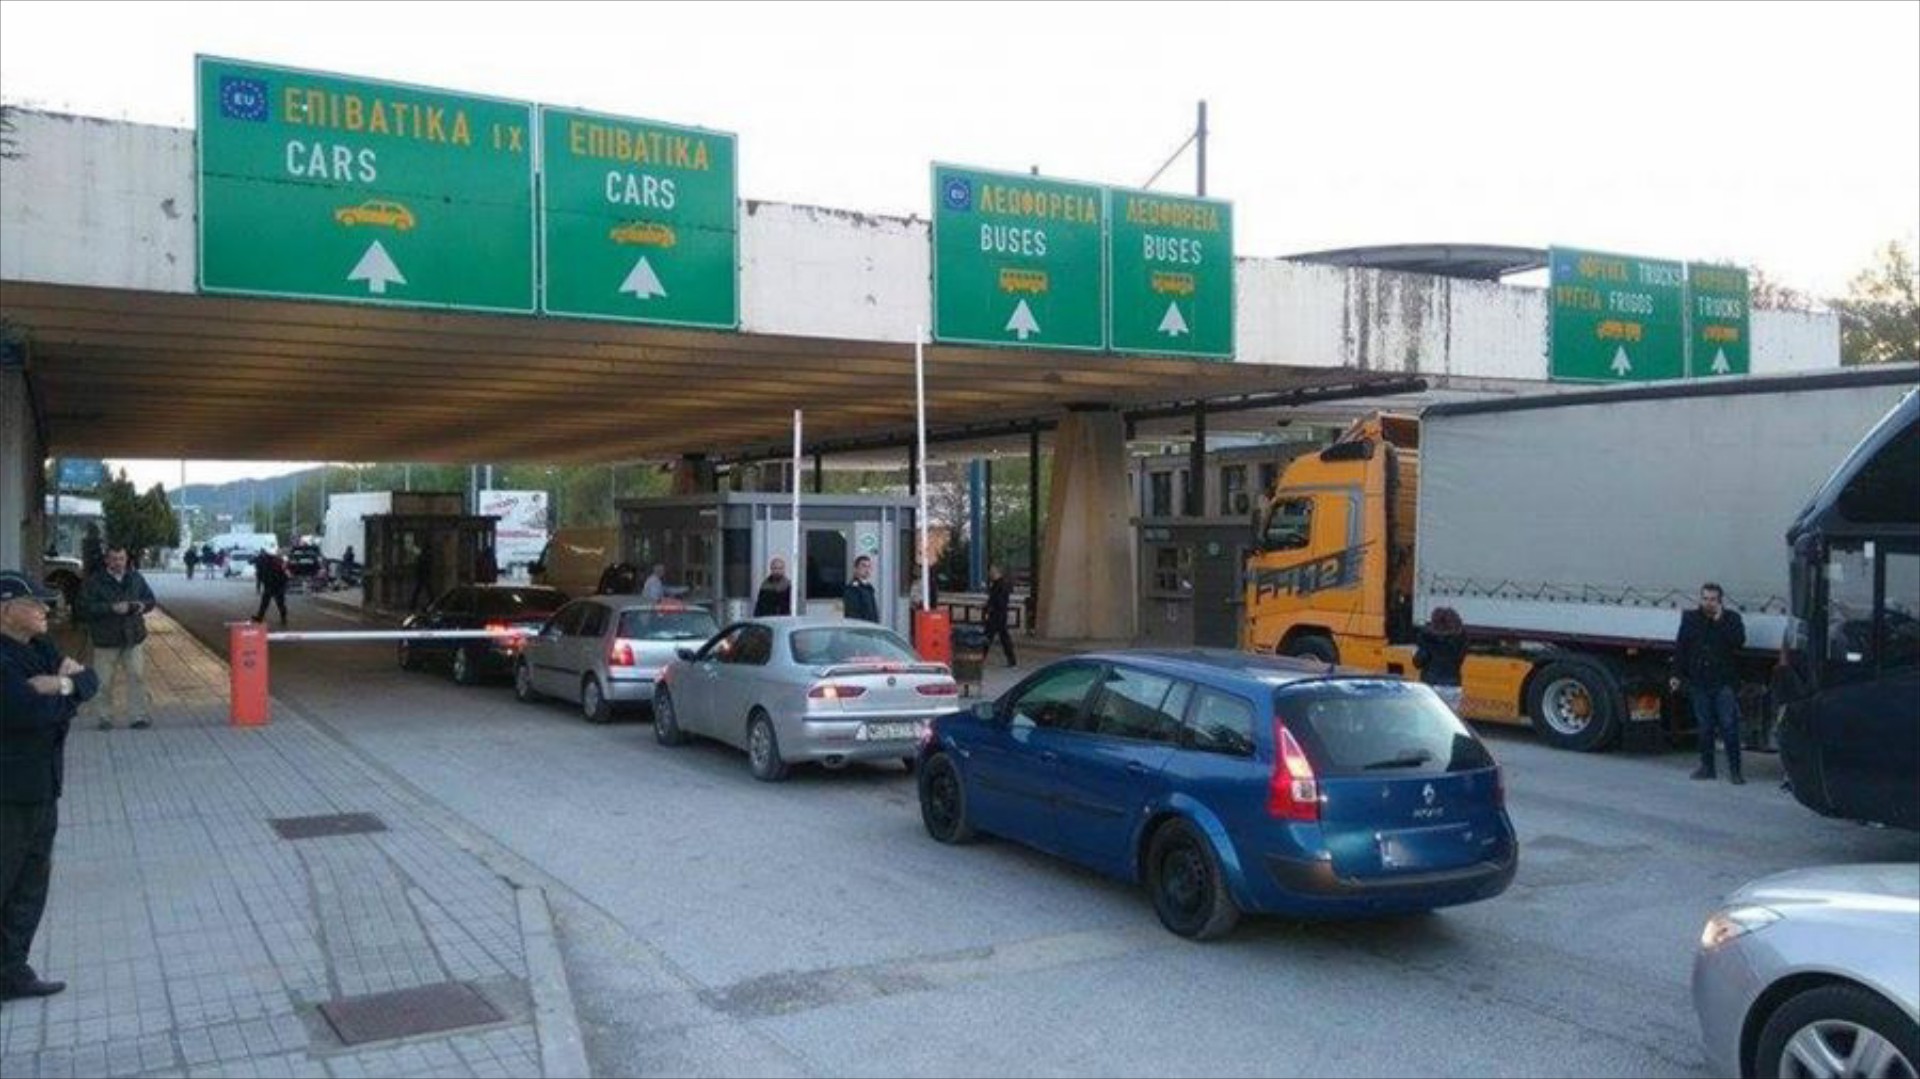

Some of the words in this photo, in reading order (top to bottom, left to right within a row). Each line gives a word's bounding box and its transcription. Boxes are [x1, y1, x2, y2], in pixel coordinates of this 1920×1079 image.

[233, 92, 255, 106] EU
[283, 86, 471, 146] ΕΠΙΒΑΤΙΚΑ
[286, 140, 377, 183] CARS
[570, 120, 709, 171] ΕΠΙΒΑΤΙΚΑ
[605, 170, 676, 210] CARS
[979, 223, 1048, 257] BUSES
[1142, 233, 1203, 265] BUSES
[1638, 262, 1683, 288] TRUCKS
[1697, 295, 1742, 320] TRUCKS
